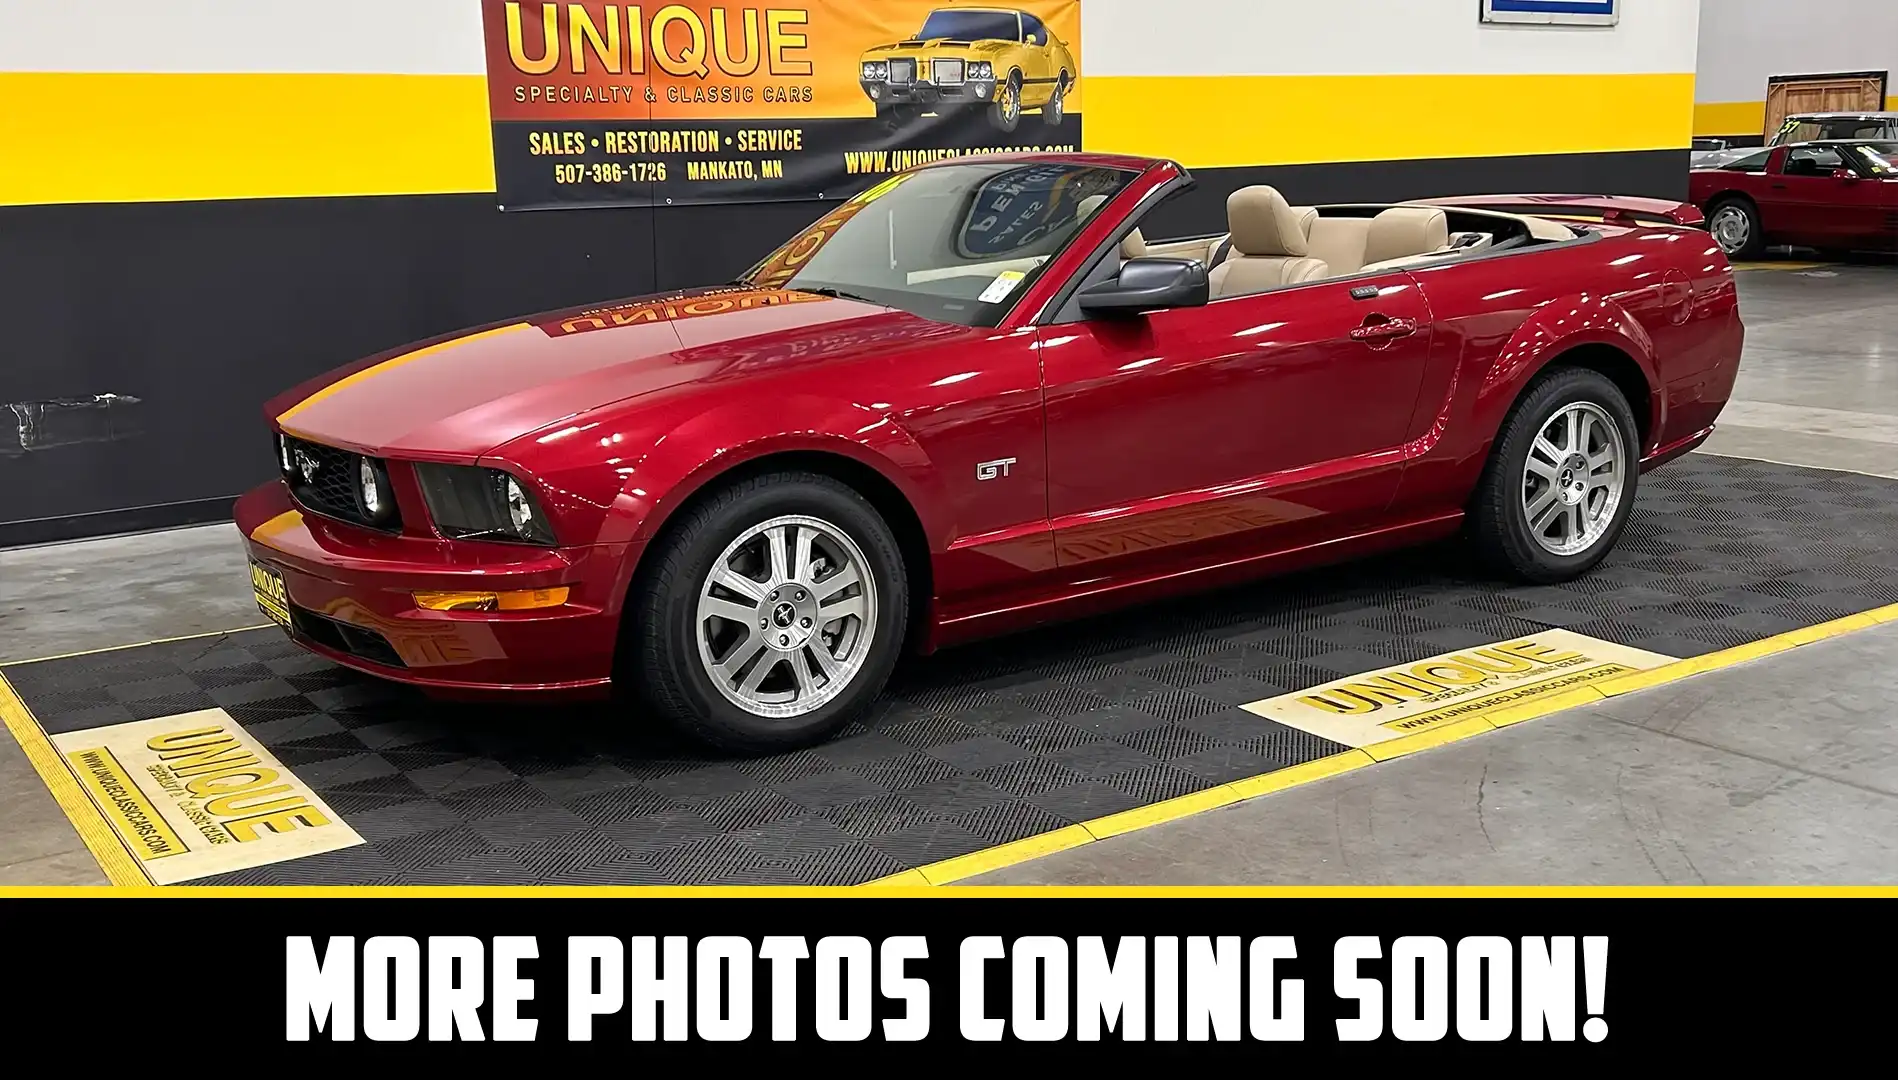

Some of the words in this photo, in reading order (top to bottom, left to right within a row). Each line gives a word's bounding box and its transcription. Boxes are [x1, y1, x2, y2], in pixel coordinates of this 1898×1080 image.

[504, 1, 813, 80] UNIQUE
[514, 86, 633, 102] SPECIALTY
[644, 85, 657, 103] &
[667, 85, 754, 103] CLASSIC
[763, 86, 813, 103] CARS
[529, 131, 586, 155] SALES
[604, 130, 719, 154] RESTORATION
[737, 129, 802, 152] SERVICE
[555, 162, 667, 184] 507-386-1726
[687, 160, 758, 181] MANKATO,
[761, 159, 783, 178] MN
[977, 457, 1017, 481] GT
[249, 561, 288, 604] UNIQUE
[1297, 639, 1584, 715] UNIQUE
[1400, 667, 1625, 729] WWW.UNIQUECLASSICCARS.COM
[147, 725, 331, 843] UNIQUE
